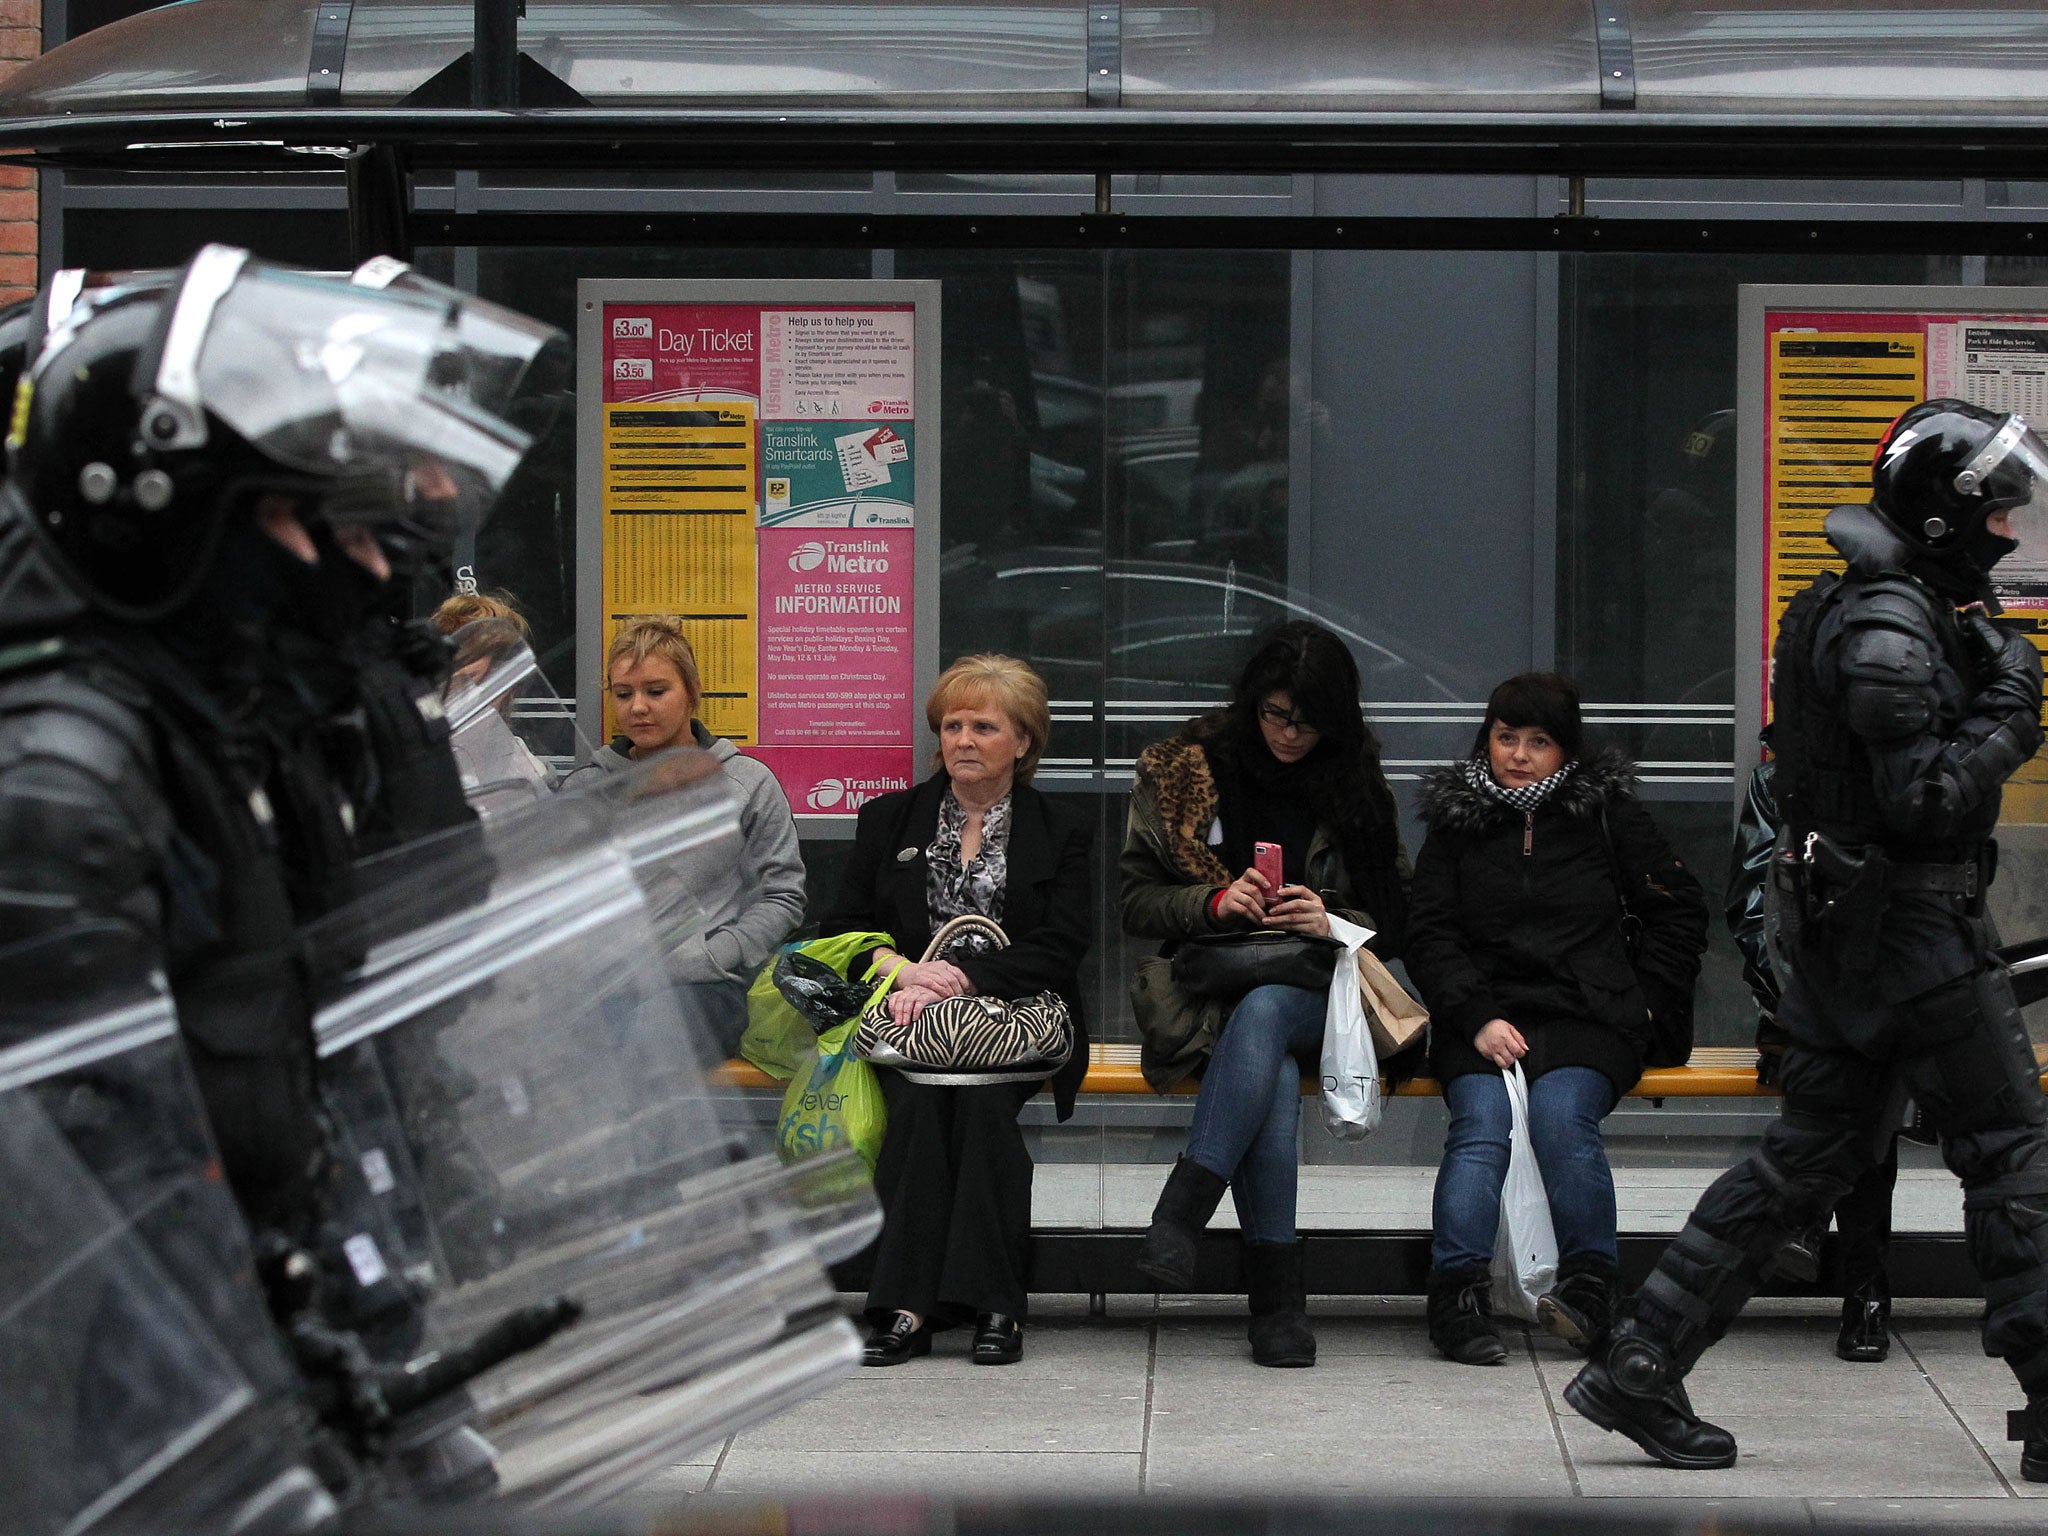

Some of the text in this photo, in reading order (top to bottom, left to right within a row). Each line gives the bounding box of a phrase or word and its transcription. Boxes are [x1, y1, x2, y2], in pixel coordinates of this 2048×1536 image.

[788, 317, 873, 327] Help us to help you
[659, 329, 695, 356] Day
[698, 328, 753, 351] Ticket
[1933, 327, 1948, 375] Metro
[615, 362, 644, 378] £3.50
[765, 315, 784, 414] Using Metro
[883, 405, 909, 414] Metro
[765, 433, 819, 447] Translink
[765, 447, 833, 461] Smartcards
[878, 516, 910, 524] Translink
[826, 540, 889, 553] Translink
[828, 555, 889, 573] Metro
[794, 584, 882, 593] METRO SERVICE
[775, 596, 901, 614] INFORMATION
[843, 777, 908, 790] Translink
